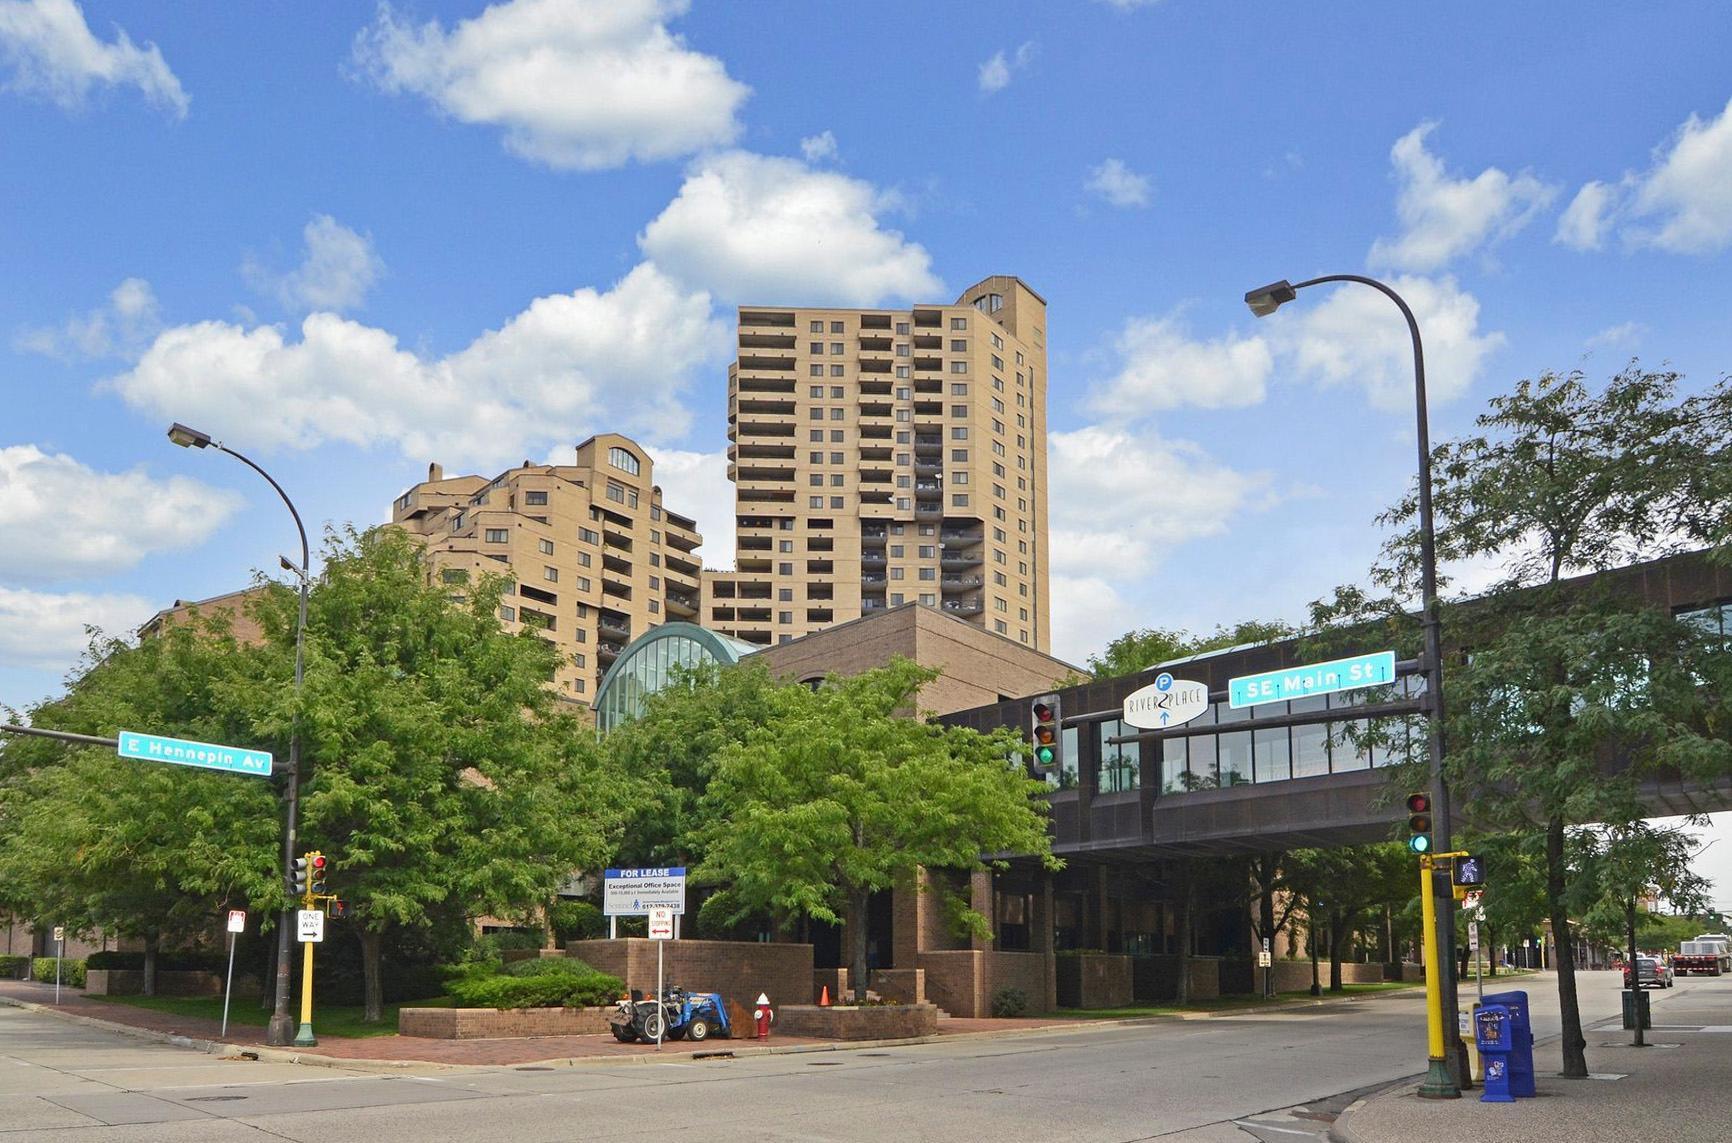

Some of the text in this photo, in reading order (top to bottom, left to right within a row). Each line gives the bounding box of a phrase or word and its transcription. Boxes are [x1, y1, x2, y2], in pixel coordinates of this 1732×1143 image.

[1160, 677, 1169, 689] P
[1247, 661, 1374, 698] SE Main St
[1129, 688, 1201, 713] RIVER PLACE
[127, 739, 265, 769] E Hennepin Av
[640, 869, 670, 877] LEASE
